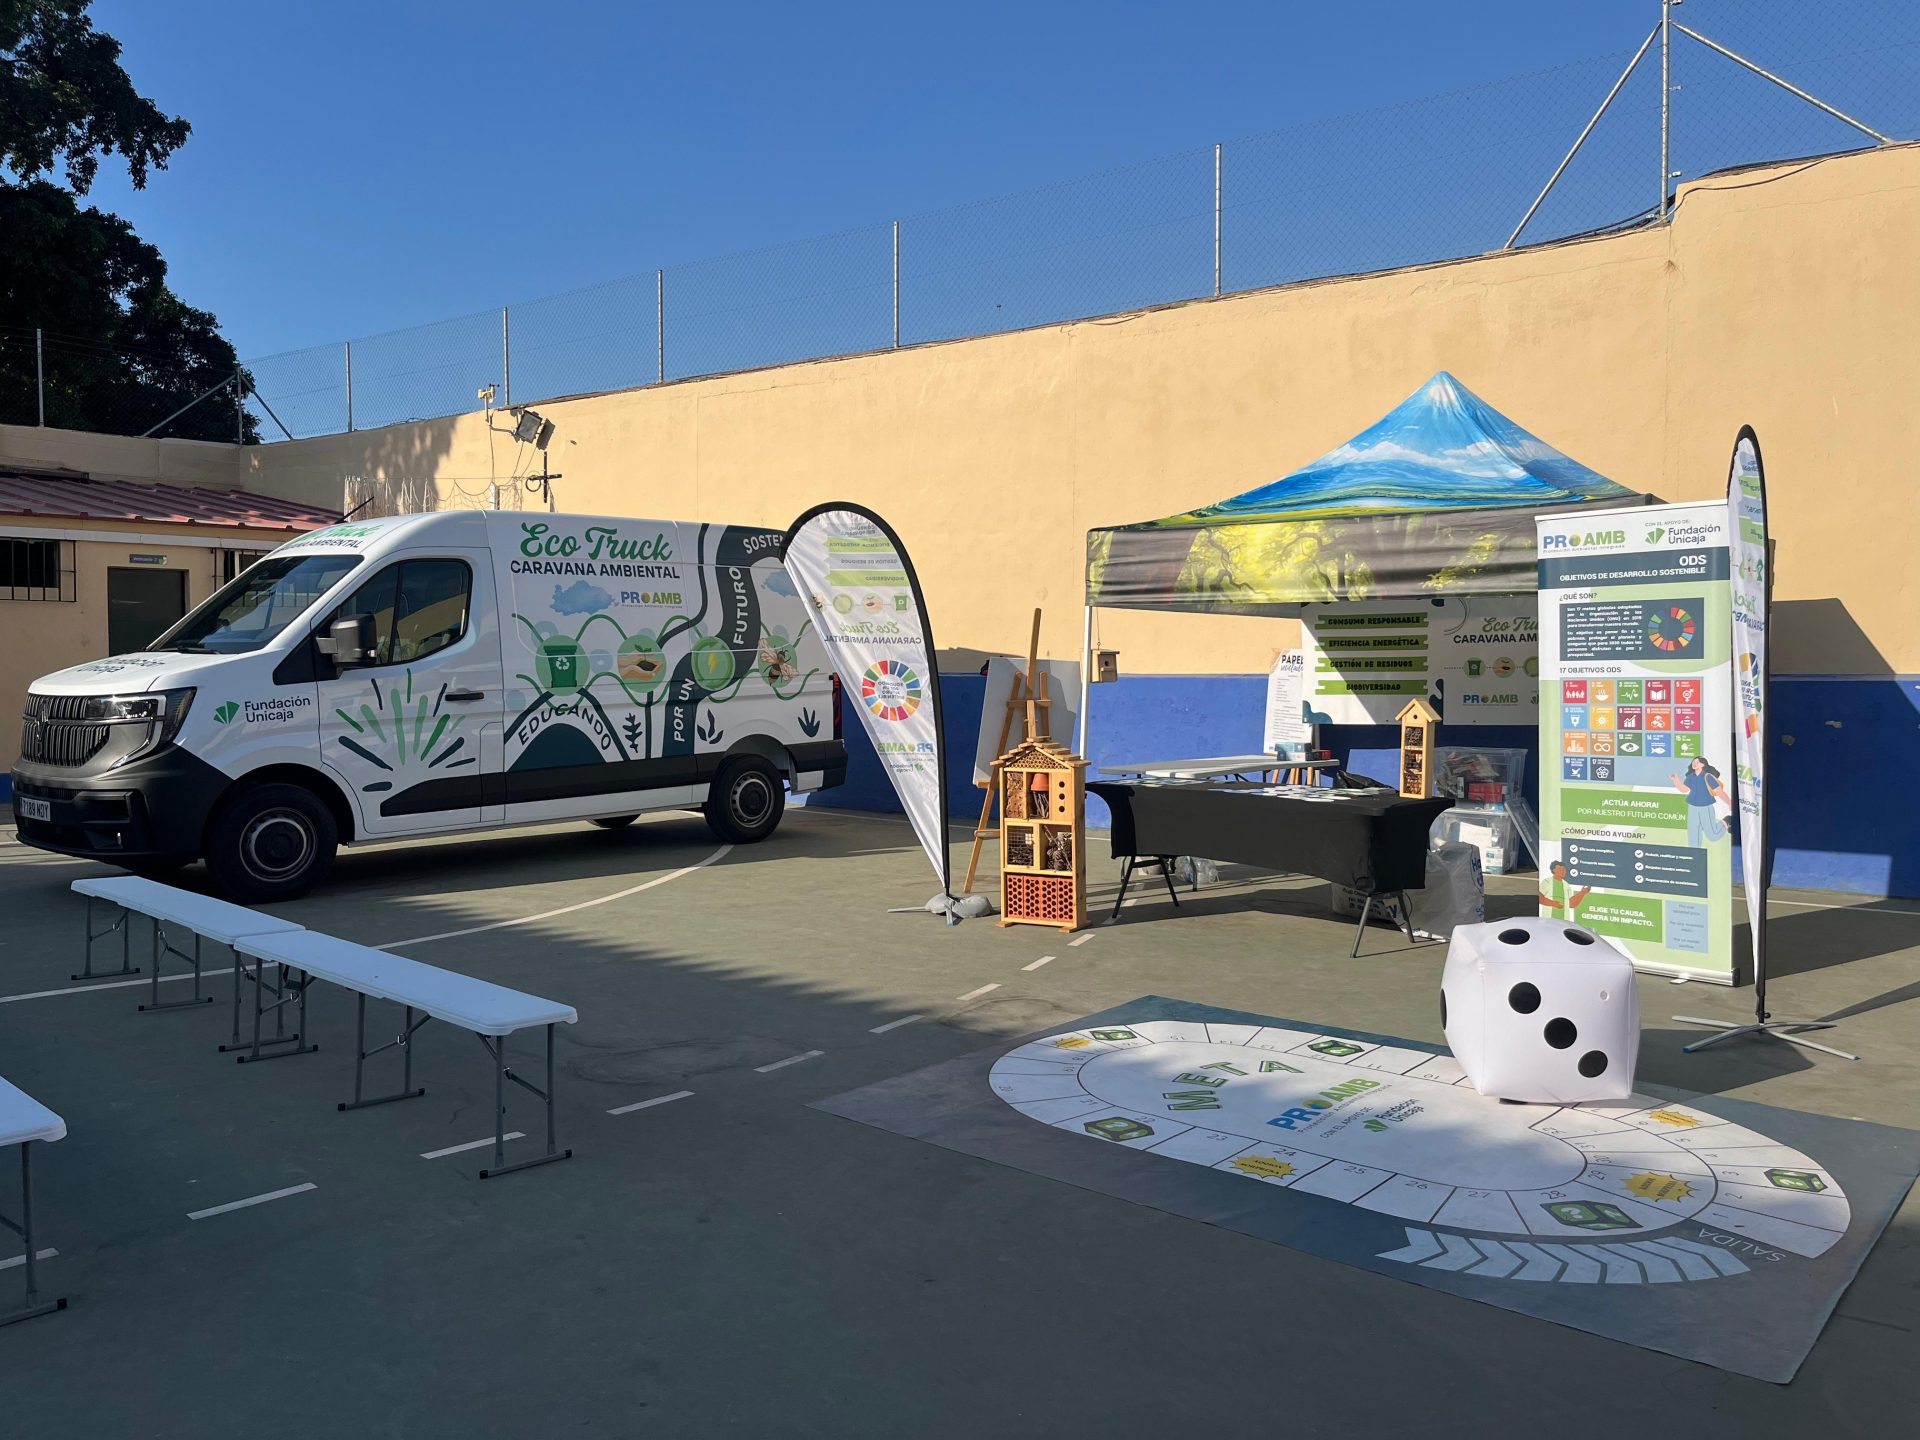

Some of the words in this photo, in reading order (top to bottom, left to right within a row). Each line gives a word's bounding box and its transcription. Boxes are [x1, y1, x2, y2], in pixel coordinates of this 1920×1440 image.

[1668, 524, 1721, 536] Fundación
[520, 522, 581, 557] Eco
[585, 526, 672, 560] Truck
[1668, 535, 1706, 545] Unicaja
[1679, 555, 1707, 566] ODS
[511, 560, 596, 576] CARAVANA
[600, 563, 680, 578] AMBIENTAL
[1560, 573, 1597, 582] OBJETIVOS
[1609, 570, 1657, 579] DESARROLLO
[1659, 567, 1706, 576] SOSTENIBLE
[1560, 592, 1577, 601] ¿QUÉ
[729, 566, 746, 645] FUTURO
[1368, 616, 1420, 624] RESPONSABLE
[1482, 618, 1510, 632] Eco
[1373, 638, 1419, 646] ENERGÉTICA
[1454, 634, 1516, 644] CARAVANA
[1330, 659, 1360, 667] GESTIÓN
[244, 696, 310, 711] Fundación
[674, 706, 684, 742] POR
[679, 678, 696, 700] UN
[246, 710, 294, 722] Unicaja
[518, 704, 611, 750] EDUCANDO
[1602, 799, 1628, 807] ¡ACTÚA
[1593, 809, 1626, 817] NUESTRO
[1627, 811, 1656, 819] FUTURO
[1658, 812, 1686, 820] COMÚN
[1561, 827, 1586, 835] ¿CÓMO
[1587, 829, 1610, 837] PUEDO
[1620, 909, 1645, 918] CAUSA.
[1582, 913, 1608, 921] GENERA
[1620, 918, 1654, 927] IMPACTO.
[1162, 1061, 1305, 1110] META
[1135, 1115, 1156, 1123] 22
[1206, 1133, 1228, 1141] 23
[1320, 1130, 1336, 1139] CON
[1273, 1148, 1297, 1157] 24
[1594, 1155, 1612, 1163] 30
[1344, 1165, 1368, 1175] 25
[1588, 1170, 1607, 1180] 29
[1404, 1180, 1428, 1190] 26
[1468, 1190, 1490, 1199] 27
[1540, 1190, 1567, 1200] 28
[1698, 1228, 1787, 1262] SALIDA
